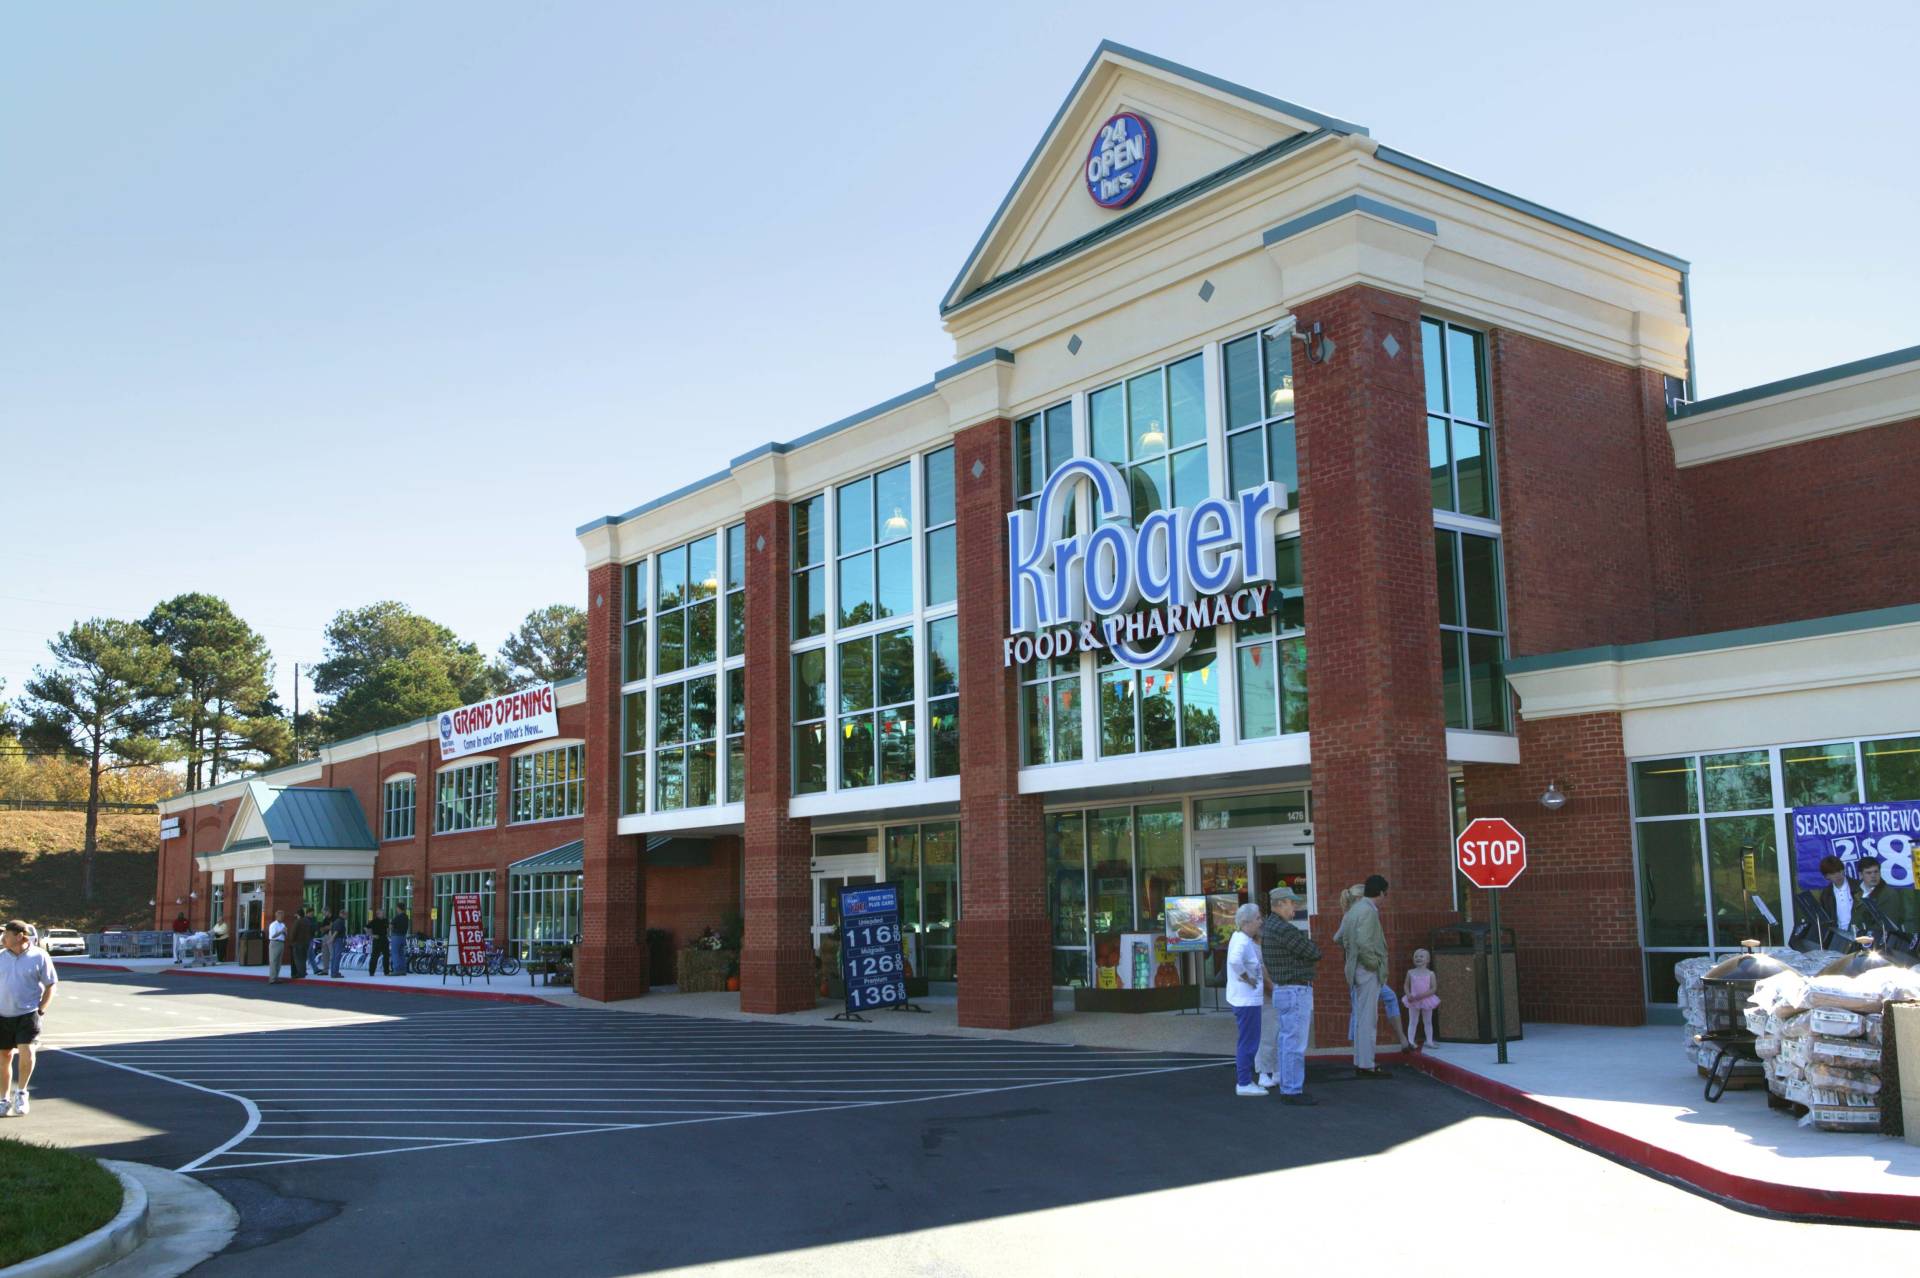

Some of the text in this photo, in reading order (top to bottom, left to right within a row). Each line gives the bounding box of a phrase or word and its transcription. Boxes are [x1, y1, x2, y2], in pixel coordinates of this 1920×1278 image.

[1101, 118, 1127, 152] 24
[1088, 134, 1144, 181] OPEN
[1007, 457, 1286, 669] Kroger
[1003, 584, 1271, 667] FOOD & PHARMACY
[454, 687, 552, 735] GRAND OPENING
[483, 733, 492, 746] and
[493, 732, 503, 743] See
[504, 726, 523, 739] What's
[1796, 812, 1865, 836] SEASONED
[1463, 840, 1520, 866] STOP
[1835, 839, 1859, 861] 2
